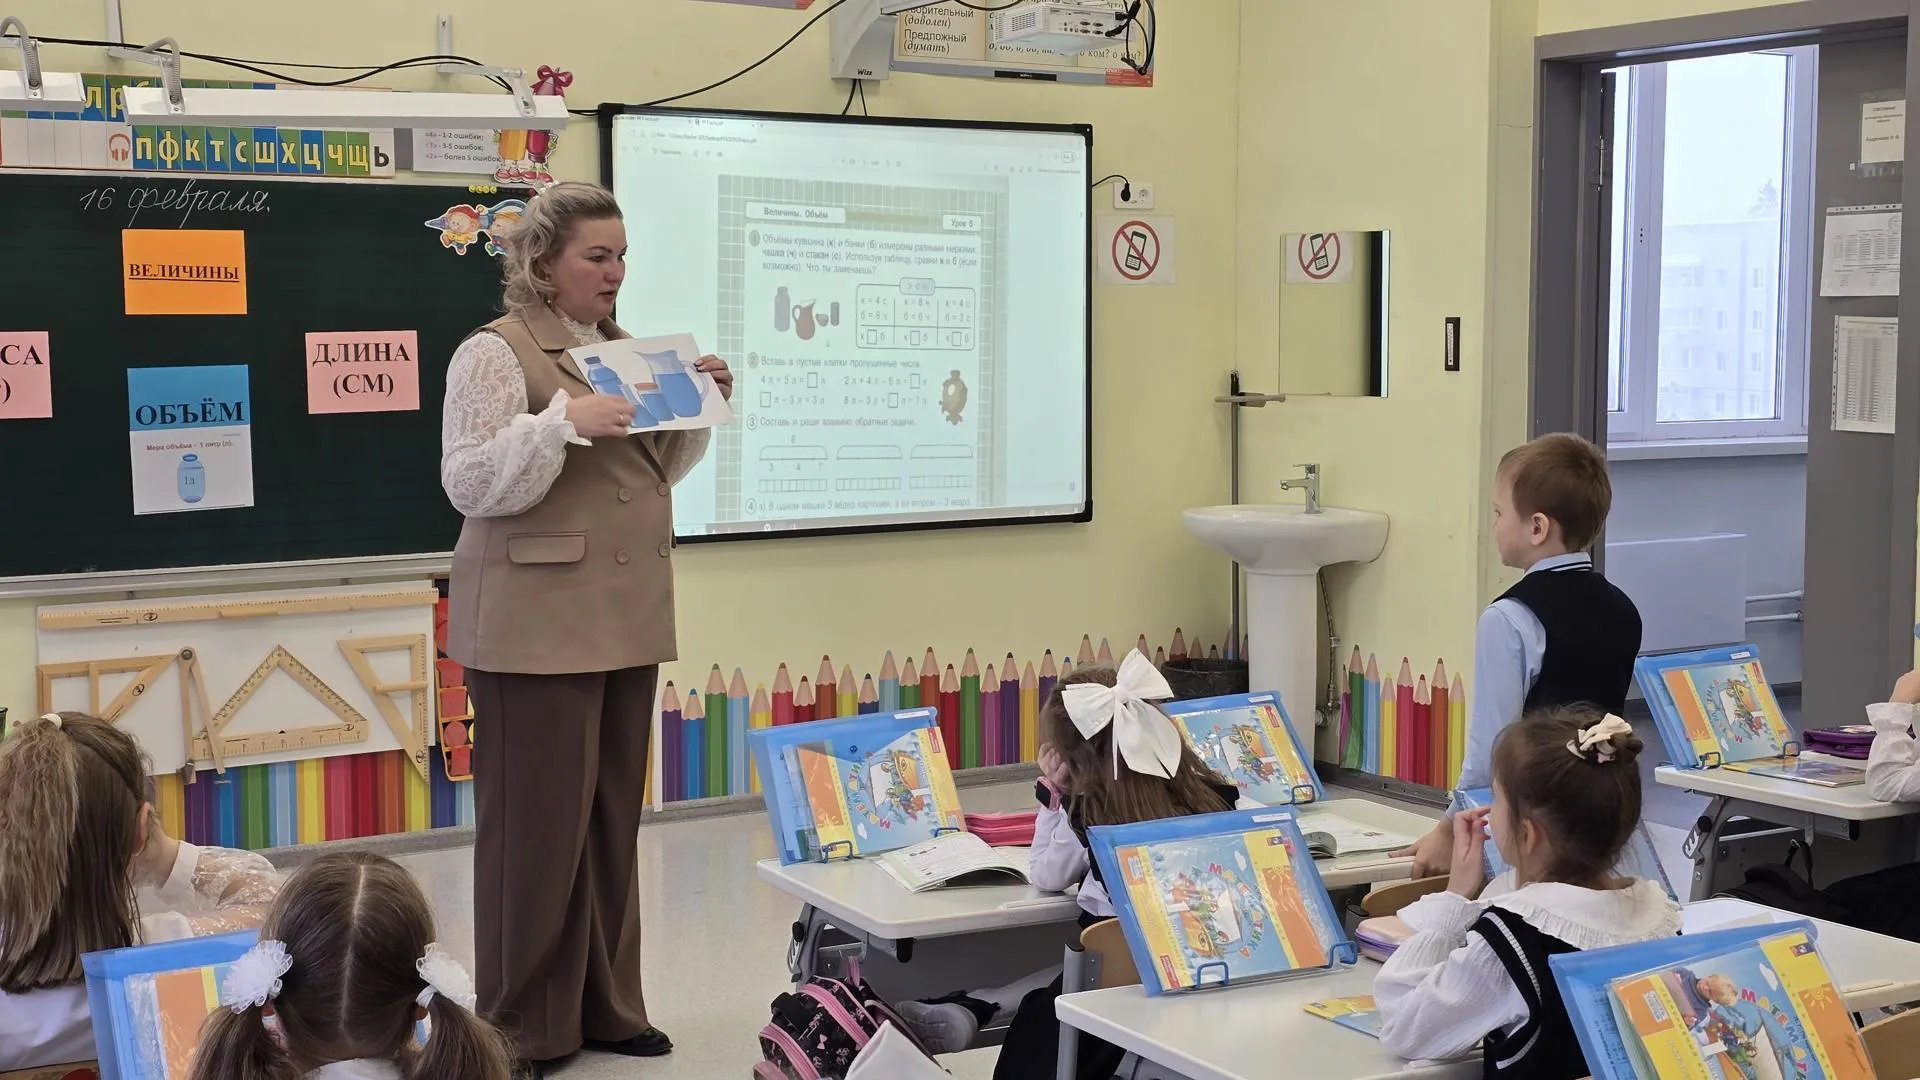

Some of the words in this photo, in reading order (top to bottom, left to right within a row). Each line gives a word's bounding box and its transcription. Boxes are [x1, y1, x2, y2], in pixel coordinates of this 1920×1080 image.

[906, 7, 974, 18] ворительный
[905, 15, 951, 29] (доволен)
[904, 29, 967, 42] Предложный
[904, 40, 950, 55] (думать)
[1121, 51, 1141, 60] чм?
[454, 132, 484, 141] ошибки;
[444, 153, 466, 161] более
[79, 185, 116, 213] 16
[127, 176, 272, 230] февраля.
[763, 206, 801, 217] Величины.
[128, 262, 240, 283] ВЕЛИЧИНЫ
[312, 341, 412, 367] ДЛИНА
[332, 374, 394, 399] (СМ)
[135, 397, 245, 426] ОБЪЁМ
[146, 444, 165, 452] Мера
